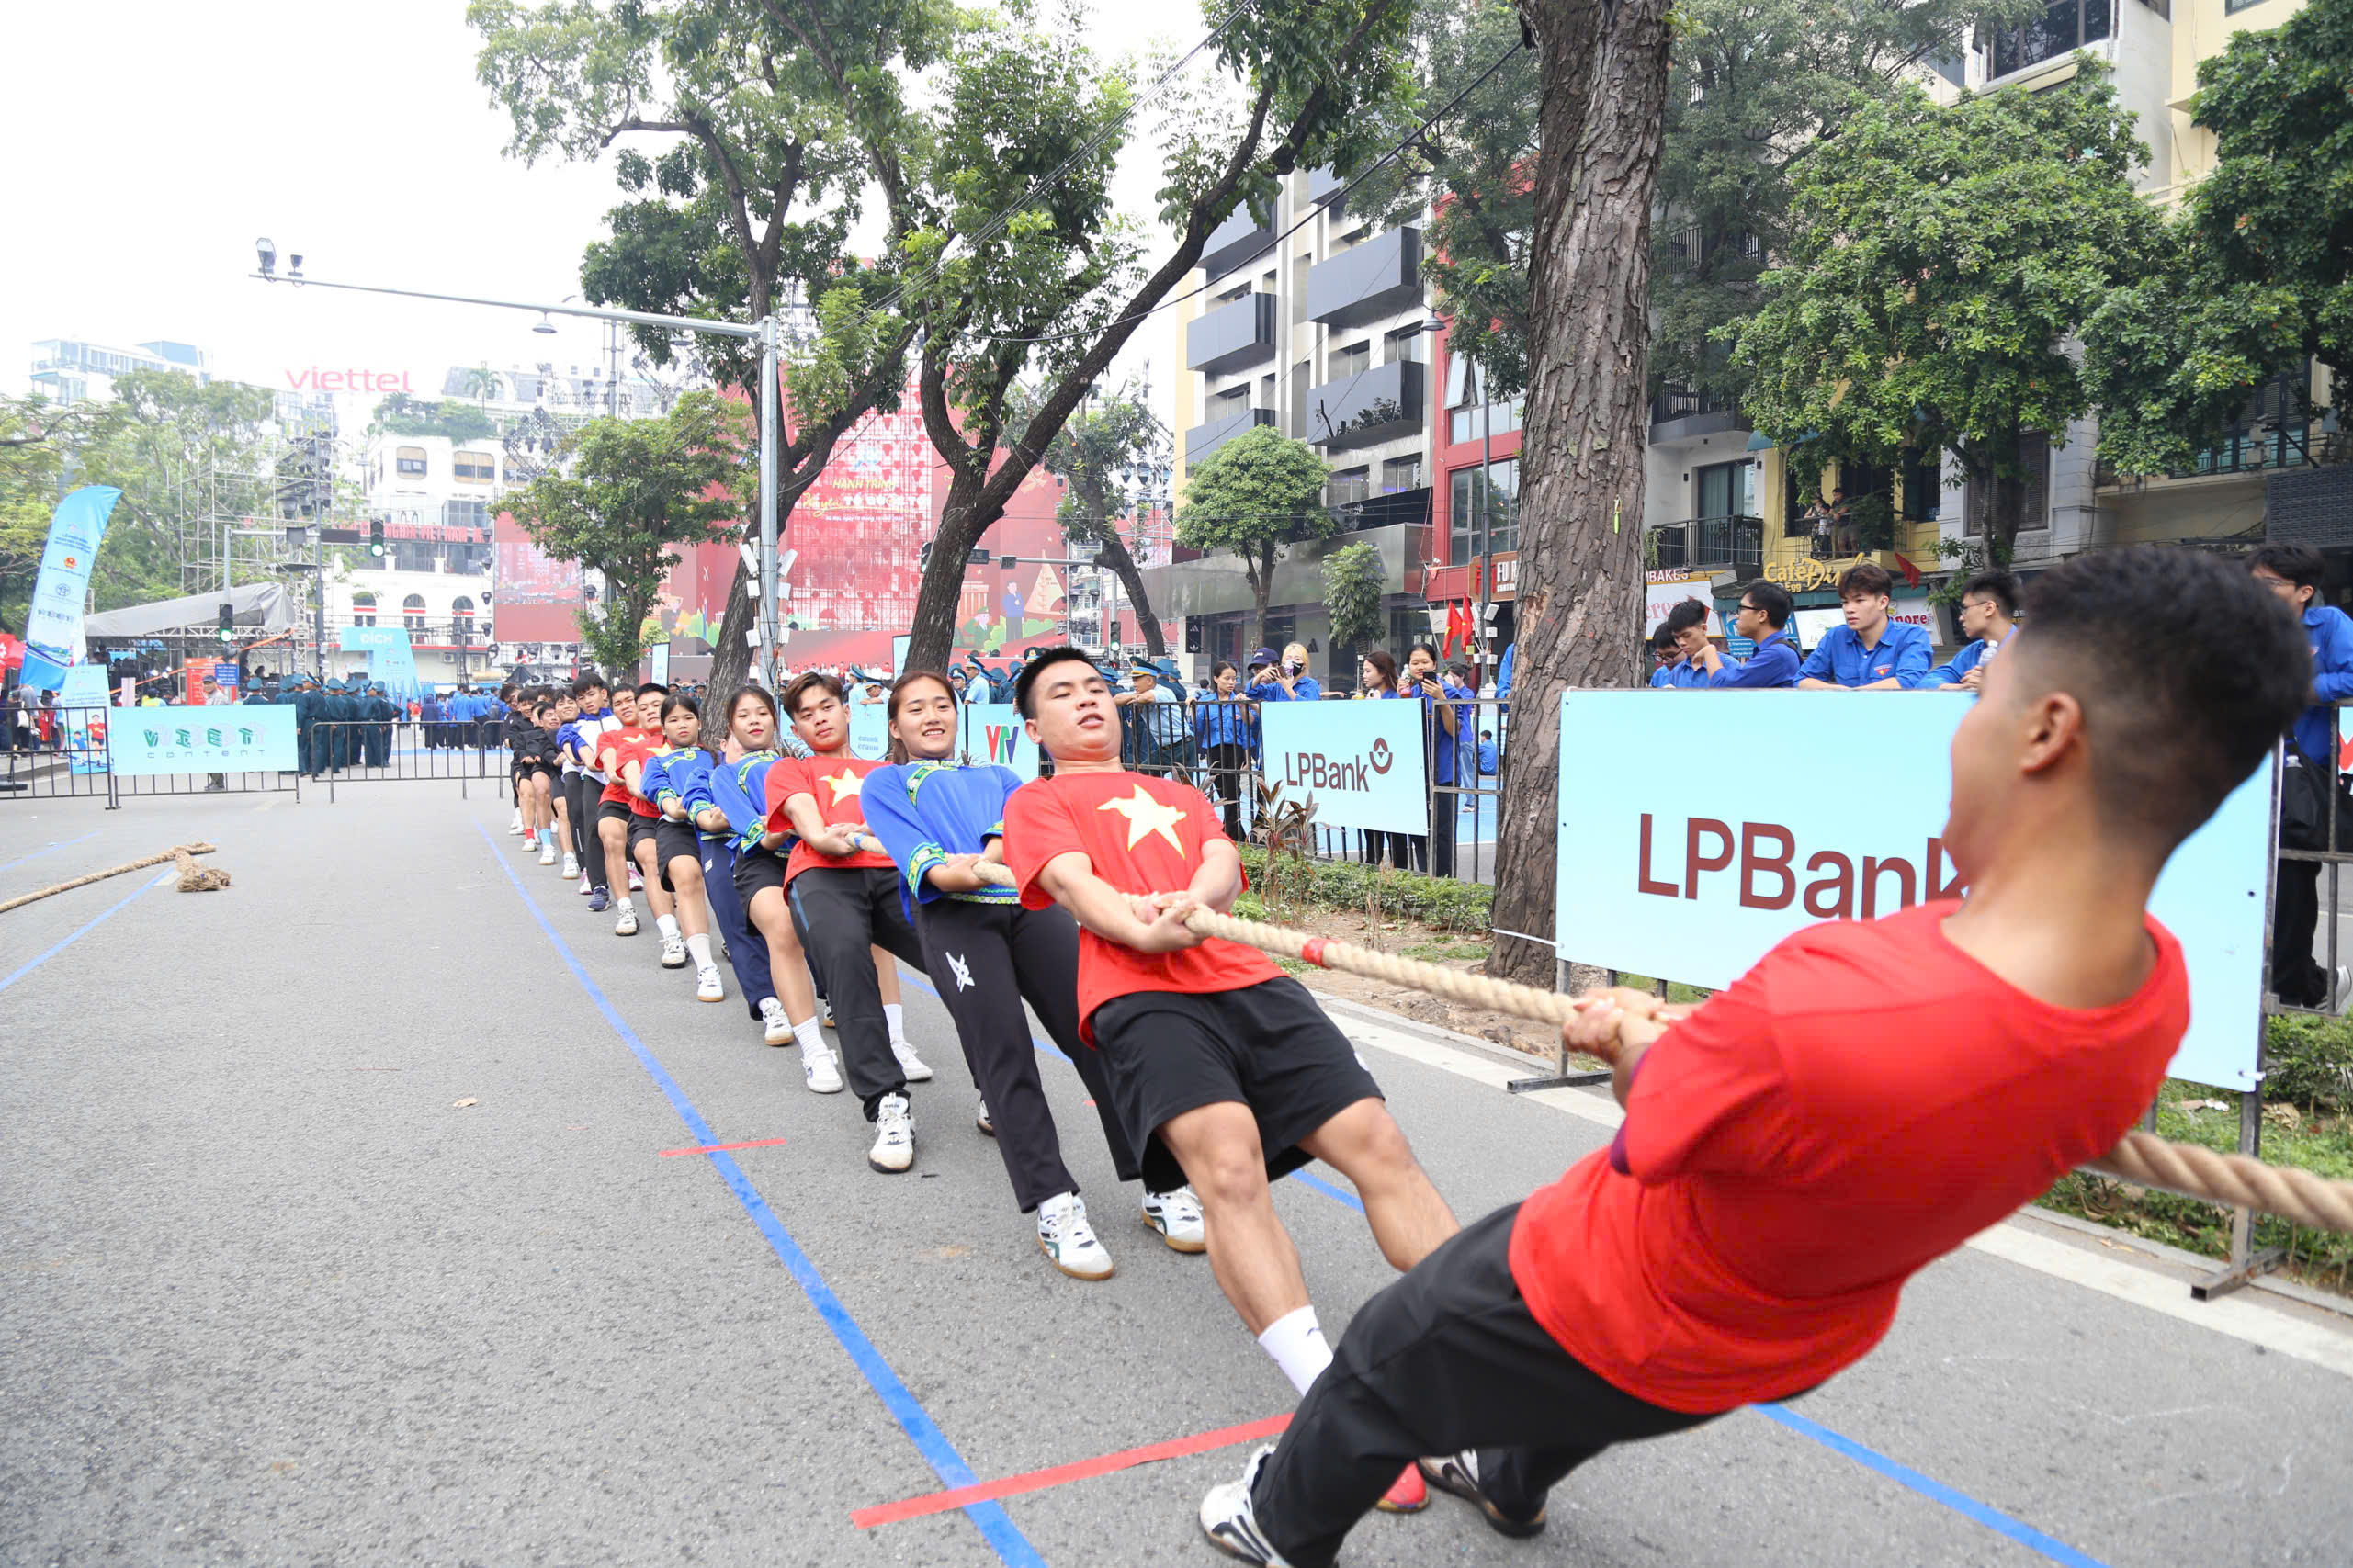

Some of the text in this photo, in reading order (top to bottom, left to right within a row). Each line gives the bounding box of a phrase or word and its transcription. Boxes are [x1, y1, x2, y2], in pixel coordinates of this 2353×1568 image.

[285, 366, 414, 393] viettel
[985, 725, 1020, 764] VTV
[1285, 751, 1370, 792] LPBank
